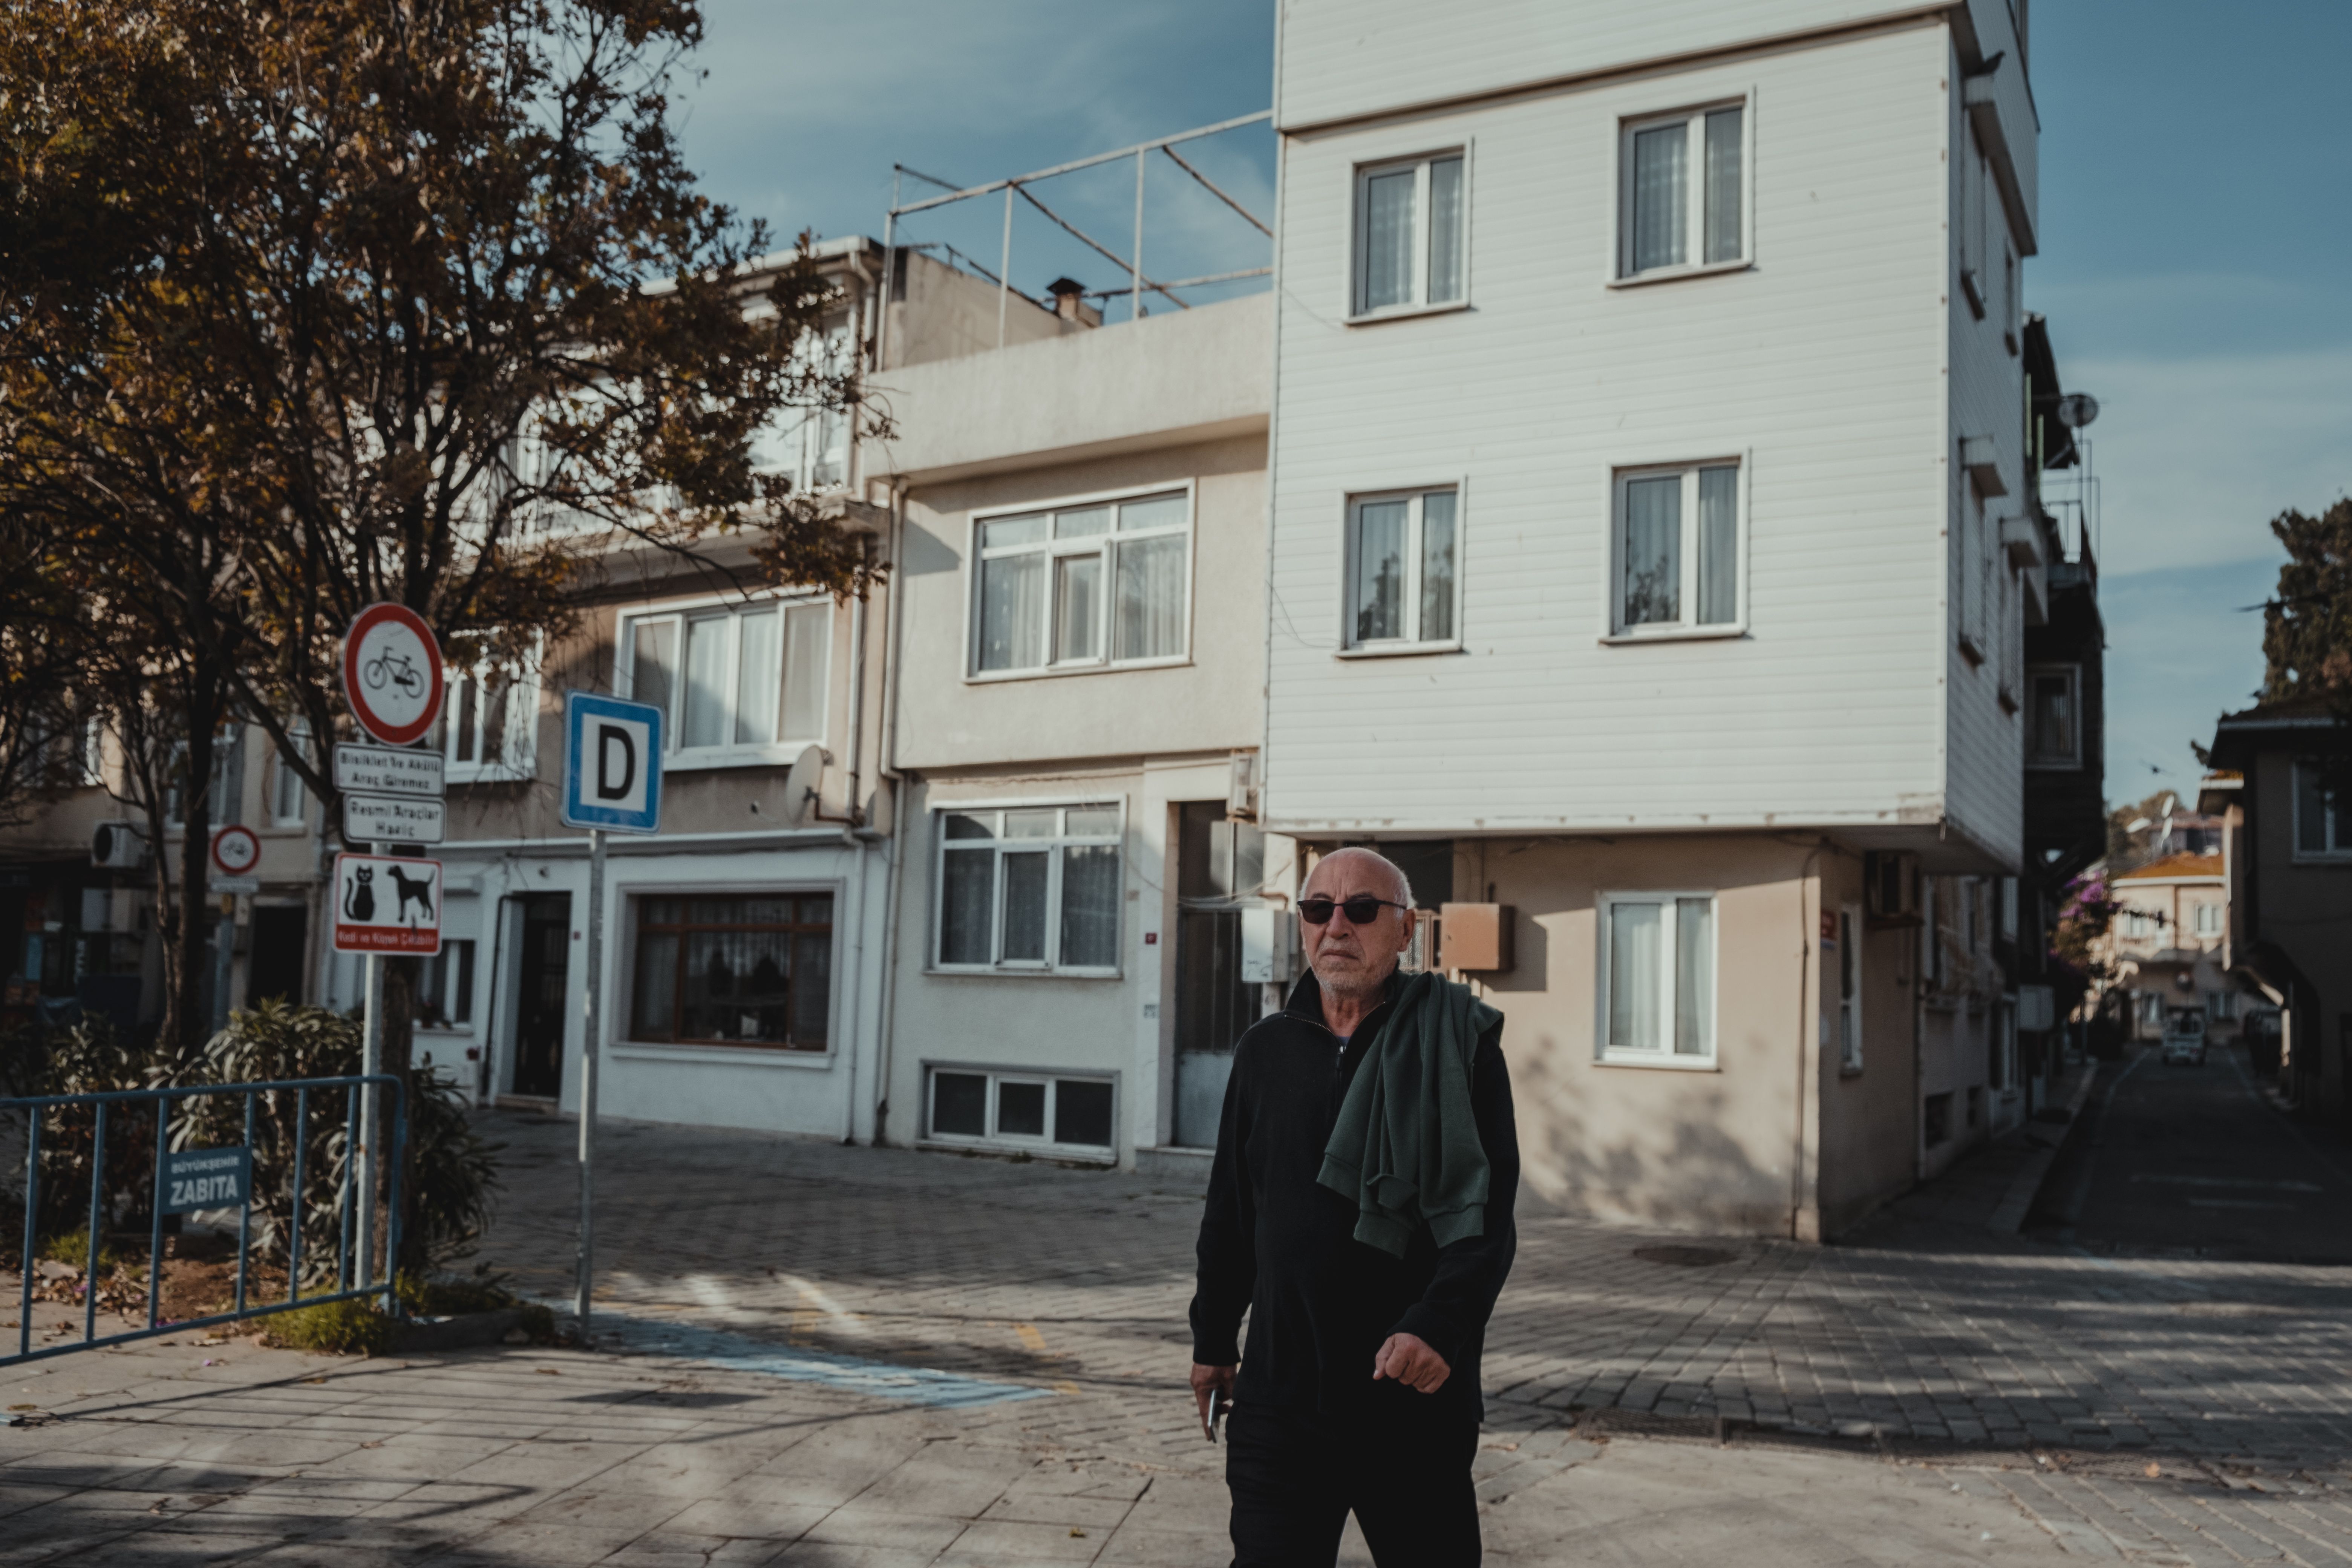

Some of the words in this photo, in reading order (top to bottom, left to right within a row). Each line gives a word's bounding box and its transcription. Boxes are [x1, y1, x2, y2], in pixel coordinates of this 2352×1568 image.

[598, 724, 636, 800] D
[352, 773, 378, 787] Araç
[384, 774, 429, 789] Giremez
[394, 805, 438, 820] Araçlar
[170, 1175, 238, 1205] ZABITA
